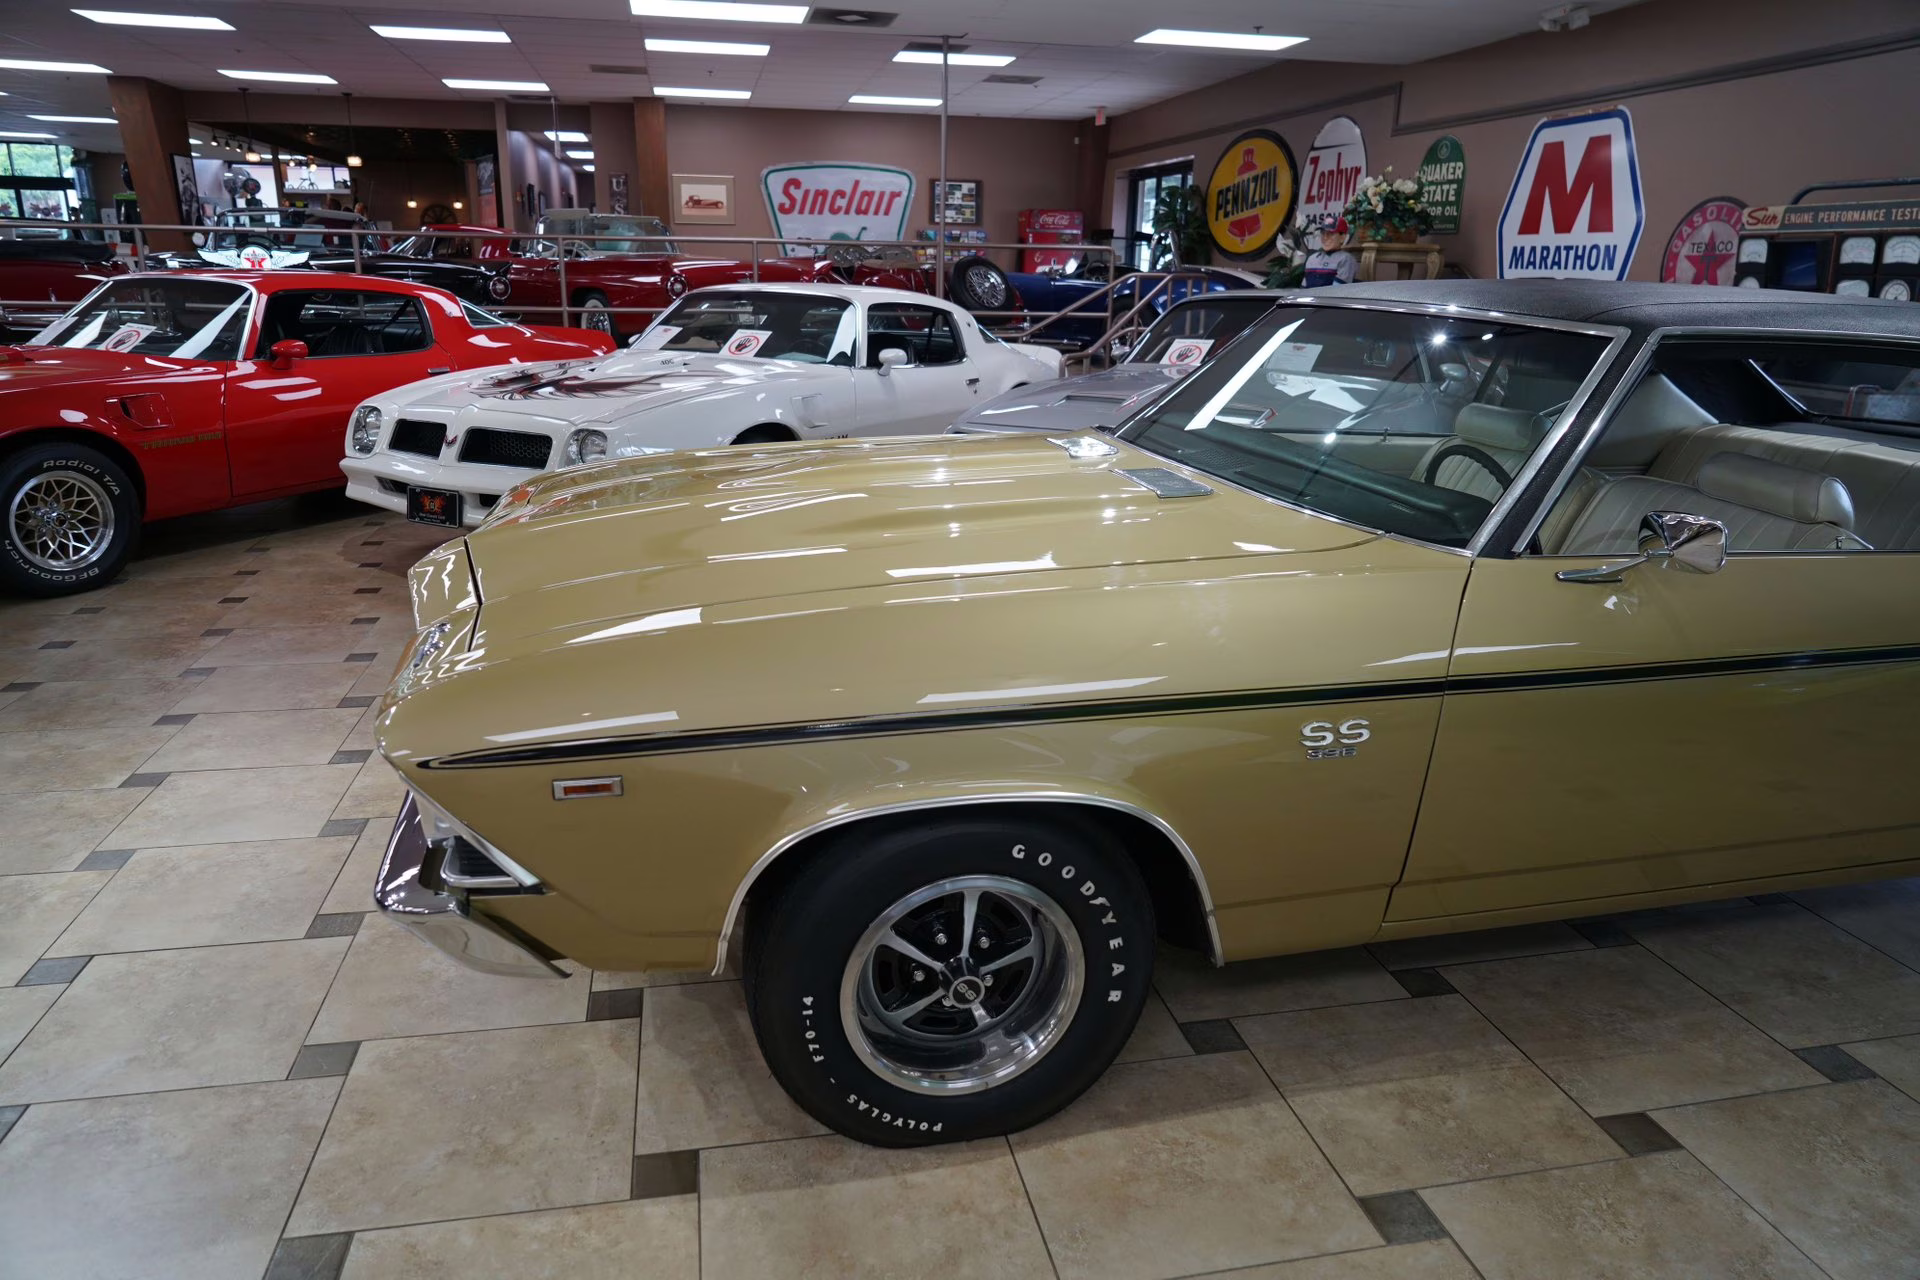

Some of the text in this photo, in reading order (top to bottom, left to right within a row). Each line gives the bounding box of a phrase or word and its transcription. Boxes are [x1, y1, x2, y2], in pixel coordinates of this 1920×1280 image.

[1304, 152, 1362, 211] Zephyr
[1421, 162, 1464, 182] QUAKER
[777, 178, 903, 217] Sinclair
[1215, 166, 1280, 222] PENNZOIL
[1420, 184, 1458, 202] STATE
[1444, 206, 1458, 217] OIL
[1746, 207, 1920, 226] Sun ENGINE PERFORMANCE TEST
[1672, 206, 1742, 253] GASOLI
[1508, 244, 1618, 271] MARATHON
[1690, 241, 1734, 254] TEXACO
[43, 459, 121, 496] Radial T/A
[4, 539, 100, 582] BFGoodrich
[1300, 719, 1371, 747] SS
[956, 982, 978, 1001] SS
[802, 995, 825, 1063] F70-14
[846, 1093, 943, 1132] POLYGLAS
